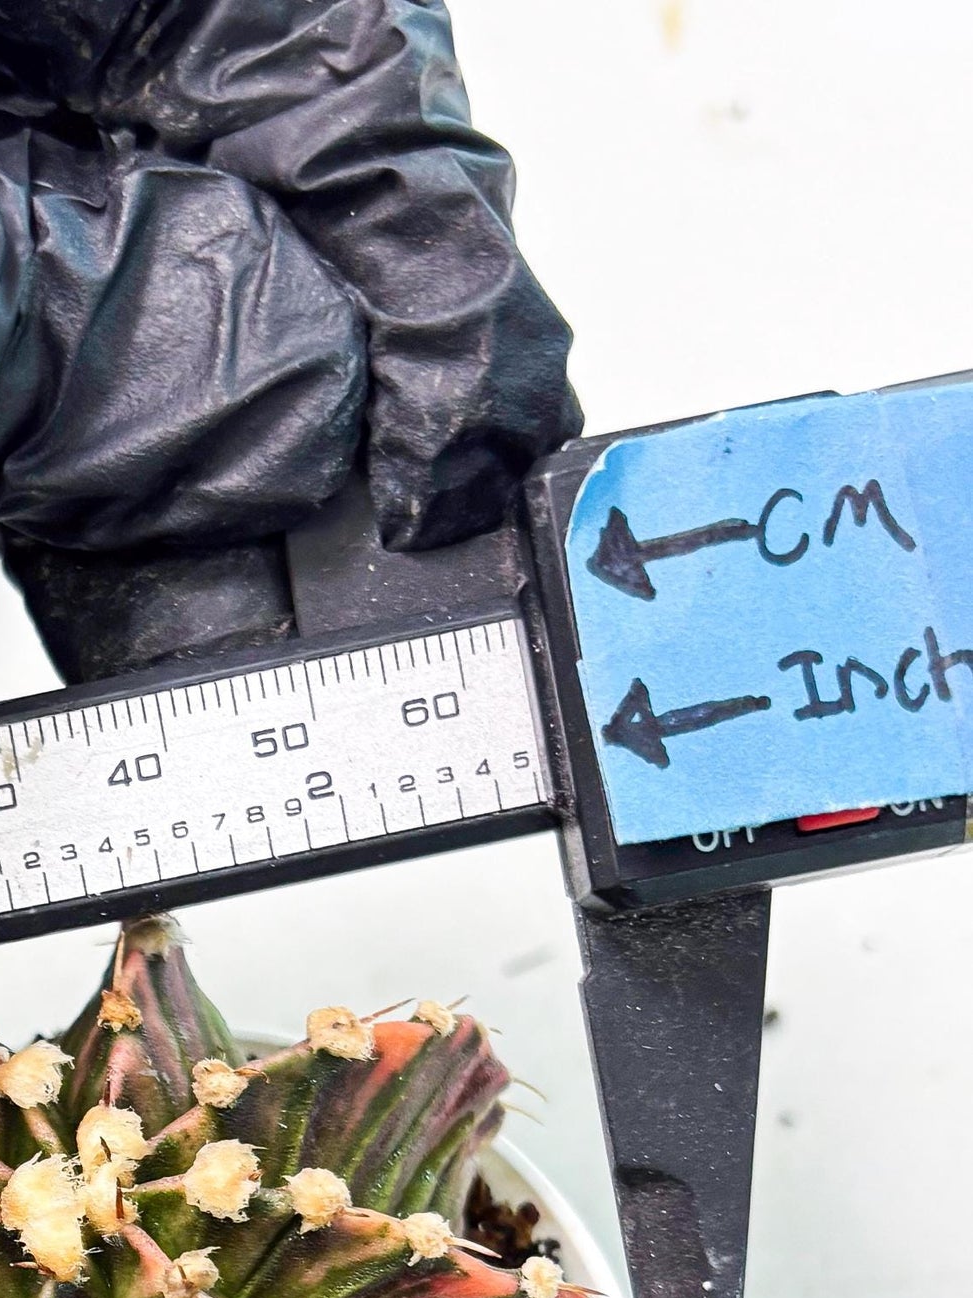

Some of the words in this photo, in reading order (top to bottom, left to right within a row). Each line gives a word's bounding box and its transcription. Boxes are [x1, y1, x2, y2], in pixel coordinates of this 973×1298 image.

[777, 626, 973, 720] Inch
[108, 753, 161, 787] 40
[251, 722, 309, 758] 50
[401, 691, 459, 727] 60
[23, 852, 41, 870] 2
[60, 844, 77, 861] 3
[98, 836, 114, 853] 4
[134, 829, 151, 846] 5
[171, 821, 189, 839] 6
[211, 813, 226, 831] 7
[246, 806, 265, 824] 8
[284, 798, 302, 816] 9
[305, 771, 335, 801] 2
[367, 782, 377, 798] 1
[398, 775, 416, 792] 2
[436, 767, 454, 784] 3
[476, 759, 491, 776] 4
[513, 751, 529, 769] 5
